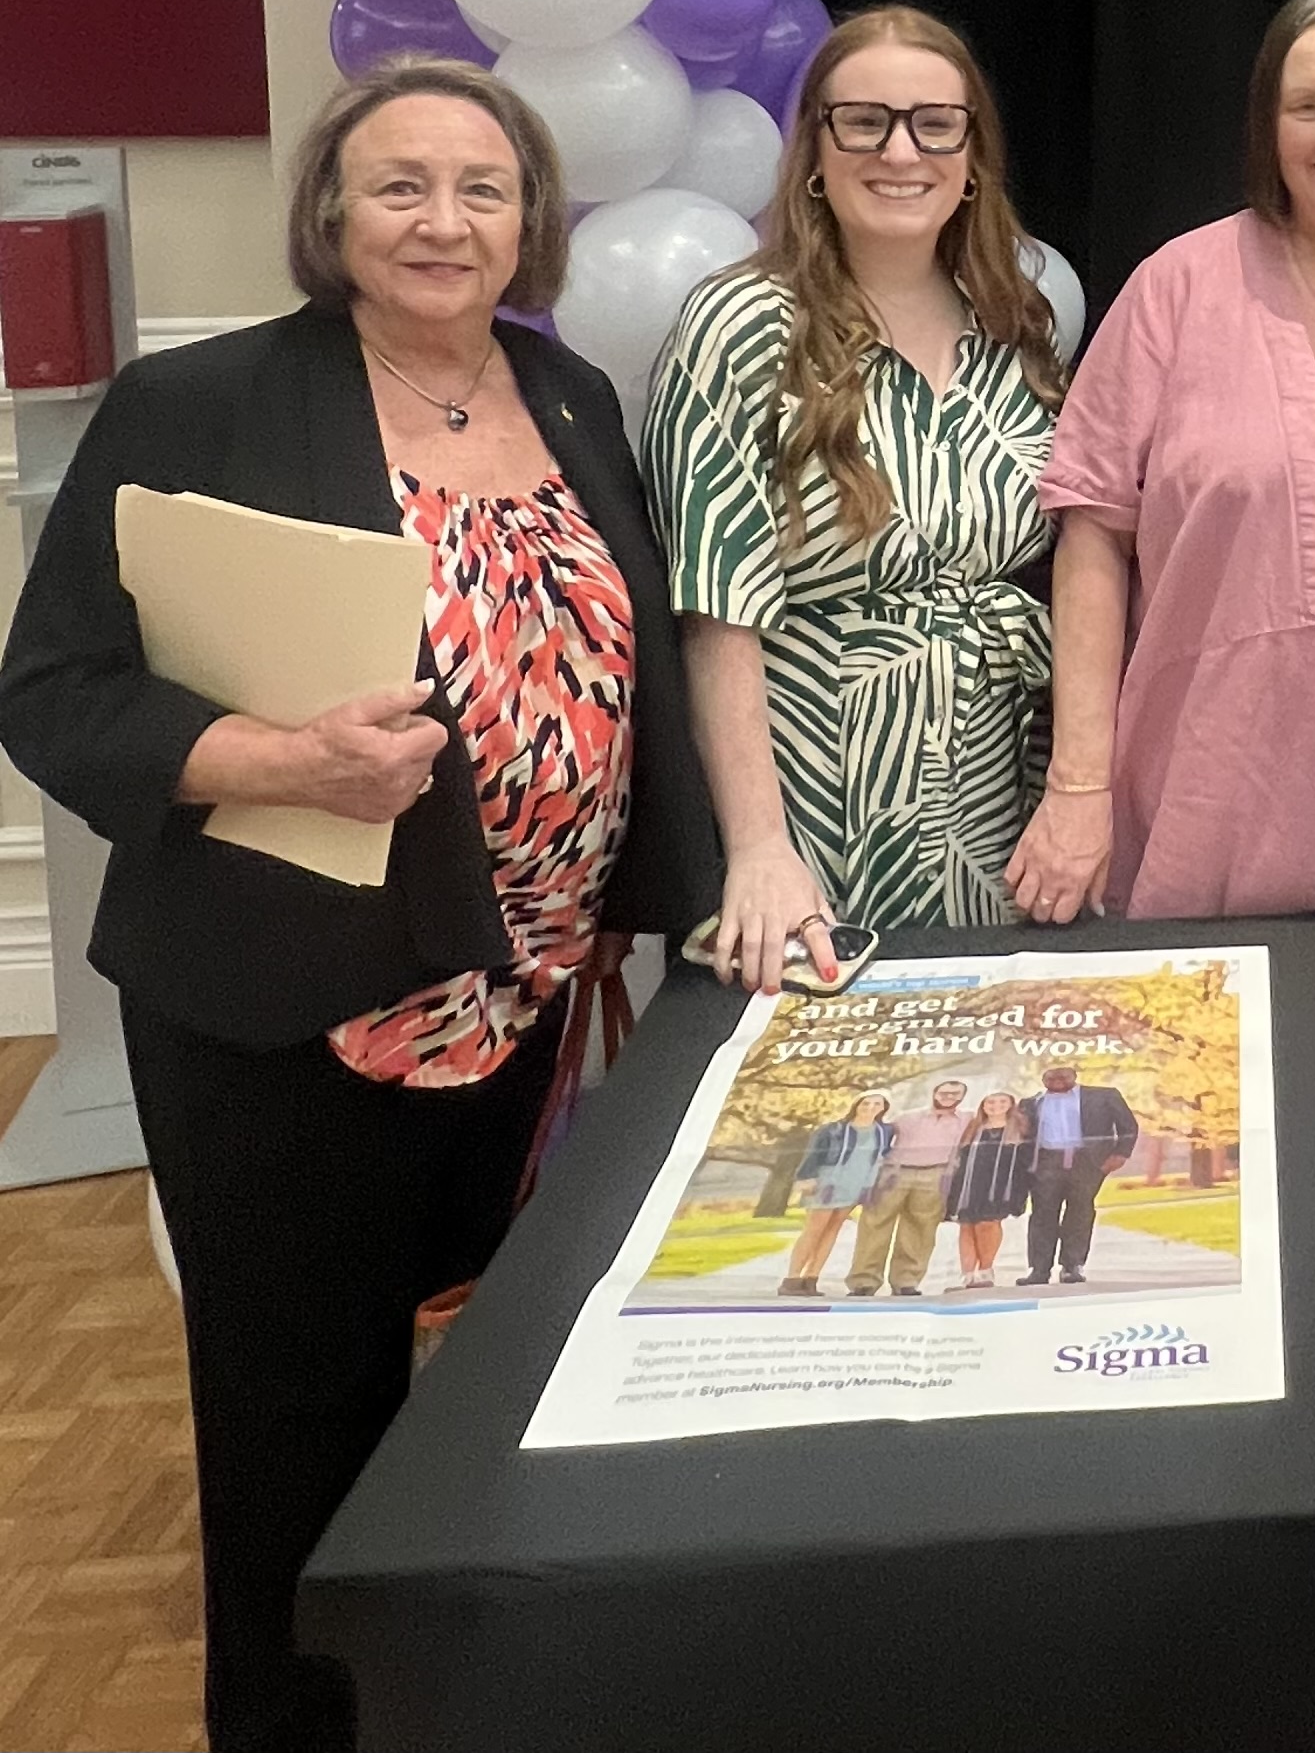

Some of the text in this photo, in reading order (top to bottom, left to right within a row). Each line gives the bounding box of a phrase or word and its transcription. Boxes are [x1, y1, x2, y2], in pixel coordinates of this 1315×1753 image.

[788, 1004, 1104, 1036] recognized for
[797, 995, 959, 1020] and get
[772, 1031, 1135, 1065] your hard work.
[1053, 1343, 1210, 1377] Sigma
